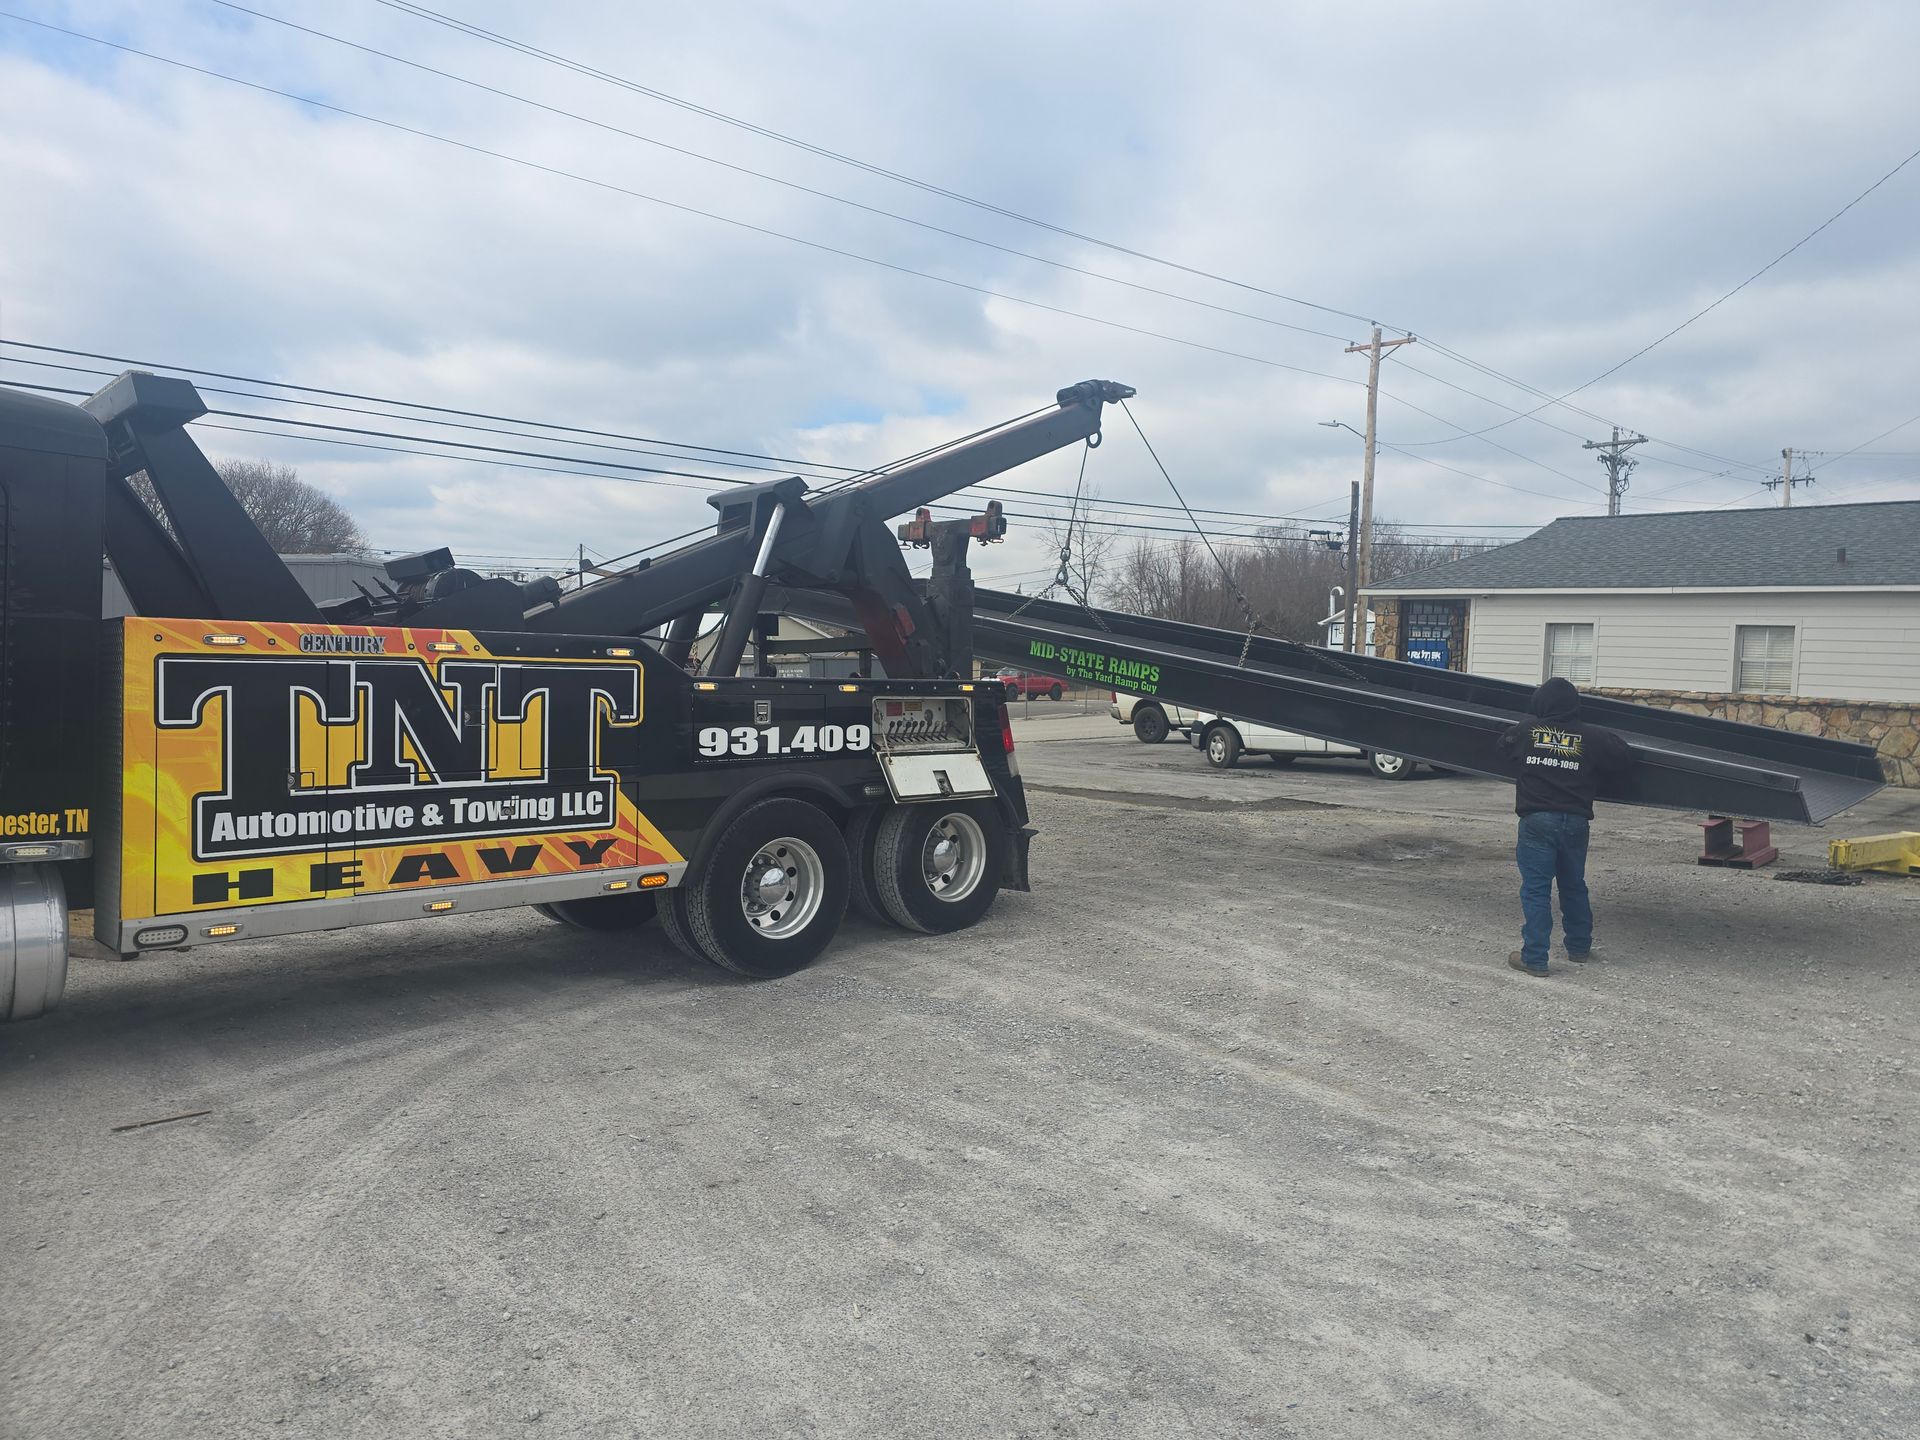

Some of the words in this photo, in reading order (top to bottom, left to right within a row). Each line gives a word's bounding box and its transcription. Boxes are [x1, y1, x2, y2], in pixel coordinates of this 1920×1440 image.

[299, 633, 386, 654] CENTURY
[1030, 641, 1105, 670] MID-STATE
[1109, 657, 1160, 682] RAMPS
[1066, 665, 1076, 677] by
[1078, 668, 1093, 680] The
[1095, 671, 1113, 684] Yard
[1115, 675, 1139, 691] Ramp
[1141, 681, 1158, 695] Guy
[156, 657, 643, 800] TNT
[698, 724, 870, 757] 931.409
[1532, 729, 1582, 750] TNT
[64, 808, 89, 833] TN
[211, 803, 414, 842] Automotive
[421, 804, 444, 826] &
[450, 795, 554, 824] Towing
[562, 790, 603, 816] LLC
[193, 838, 618, 904] HEAVY
